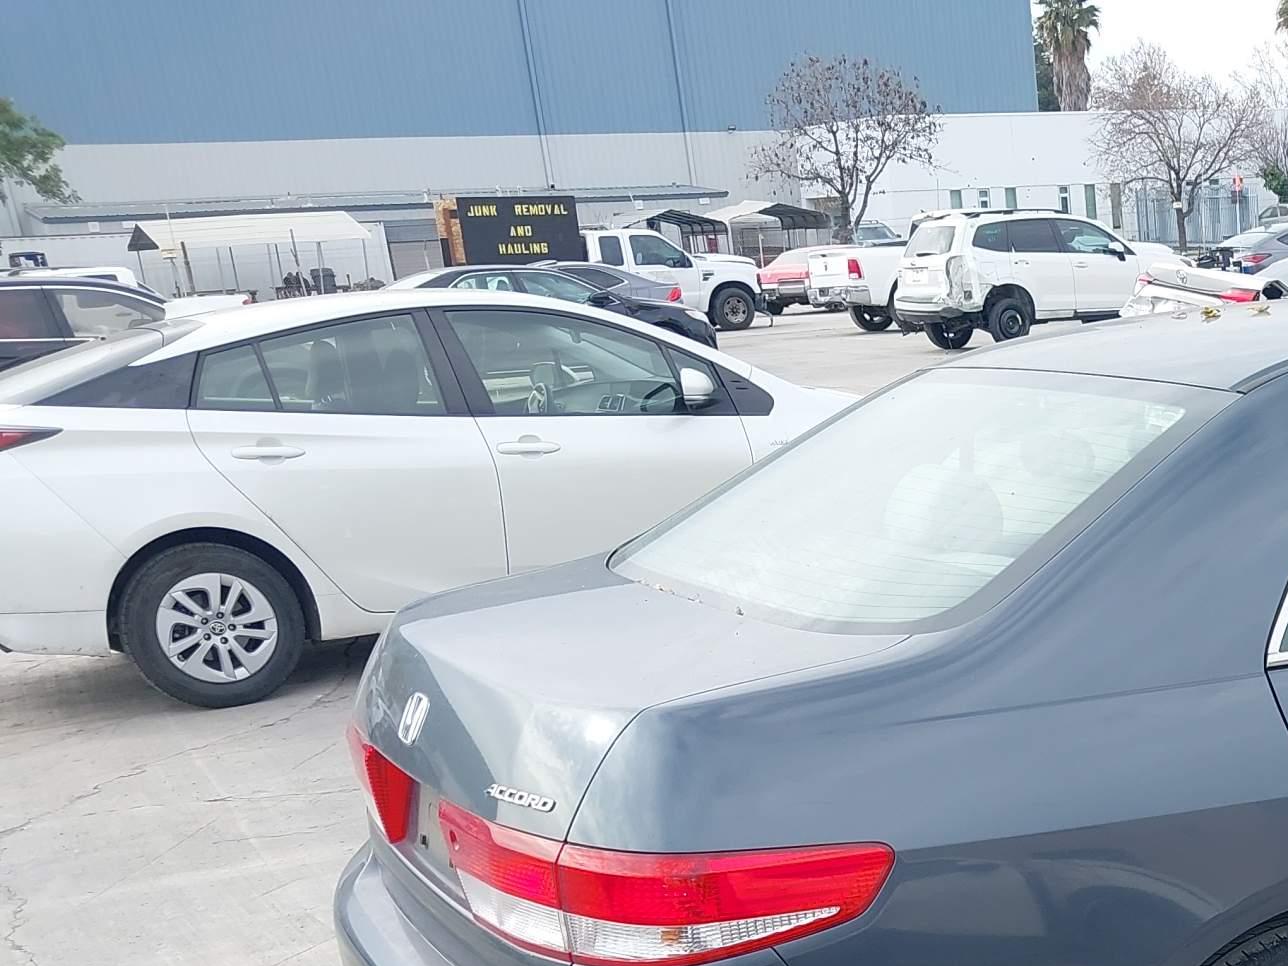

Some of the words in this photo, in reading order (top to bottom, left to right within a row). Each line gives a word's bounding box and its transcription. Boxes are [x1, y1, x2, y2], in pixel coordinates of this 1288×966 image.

[467, 205, 498, 217] JUNK
[514, 203, 568, 216] REMOVAL
[509, 225, 533, 237] AND
[498, 242, 549, 254] HAULING
[483, 783, 556, 813] ACCORD
